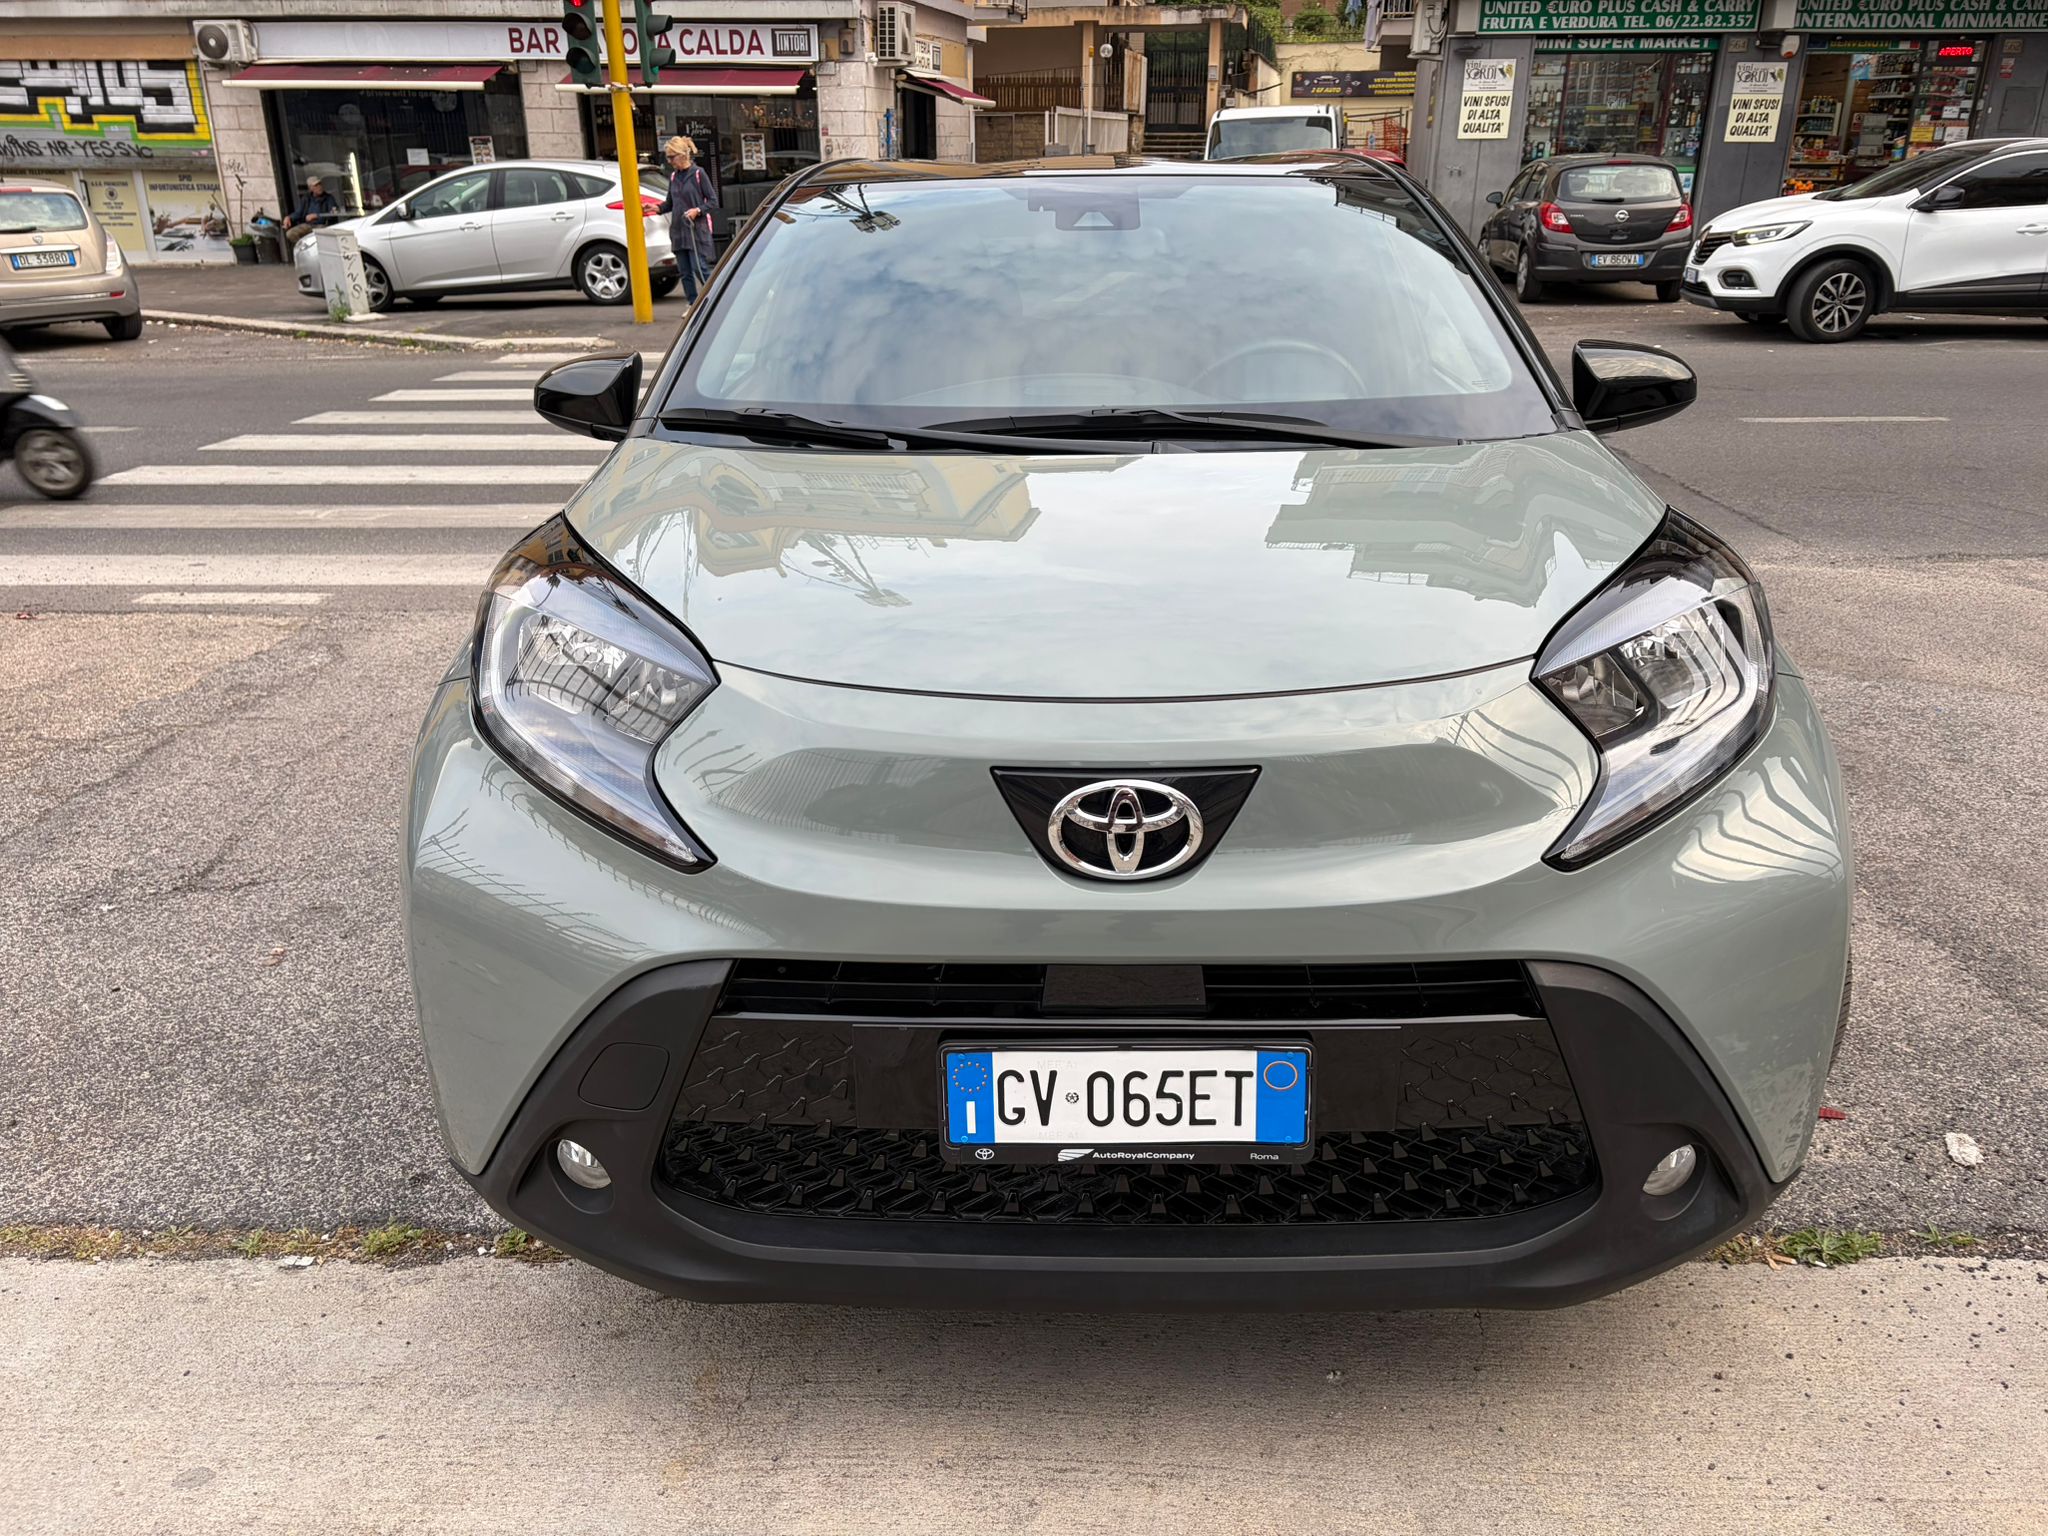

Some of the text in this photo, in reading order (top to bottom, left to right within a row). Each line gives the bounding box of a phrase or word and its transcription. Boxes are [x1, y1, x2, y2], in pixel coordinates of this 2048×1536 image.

[1484, 0, 1541, 14] UNITED
[1597, 0, 1636, 13] PLUS
[1640, 0, 1682, 13] CASH
[1687, 0, 1699, 13] &
[1704, 0, 1755, 13] CARRY
[1798, 0, 1854, 11] UNITED
[1908, 0, 1945, 11] PLUS
[1949, 0, 1991, 11] CASH
[1995, 0, 2007, 11] &
[1482, 14, 1754, 29] FRUTTA E VERDURA TEL. 06/22.82.357
[1794, 12, 1936, 28] INTERNATIONAL
[508, 27, 561, 54] BAR
[679, 28, 765, 56] CALDA
[774, 30, 809, 51] TINTORI
[1577, 37, 1635, 49] SUPER
[1639, 37, 1712, 49] MARKET
[1938, 47, 1975, 56] APERTO
[1464, 95, 1511, 107] VINI SFUSI
[1732, 99, 1781, 110] VINI SFUSI
[1467, 109, 1501, 120] DI ALTA
[1735, 112, 1769, 123] DI ALTA
[20, 254, 33, 266] DL
[997, 1069, 1254, 1127] GV 065ET
[1092, 1151, 1279, 1162] AutoRoyalCompany Roma
